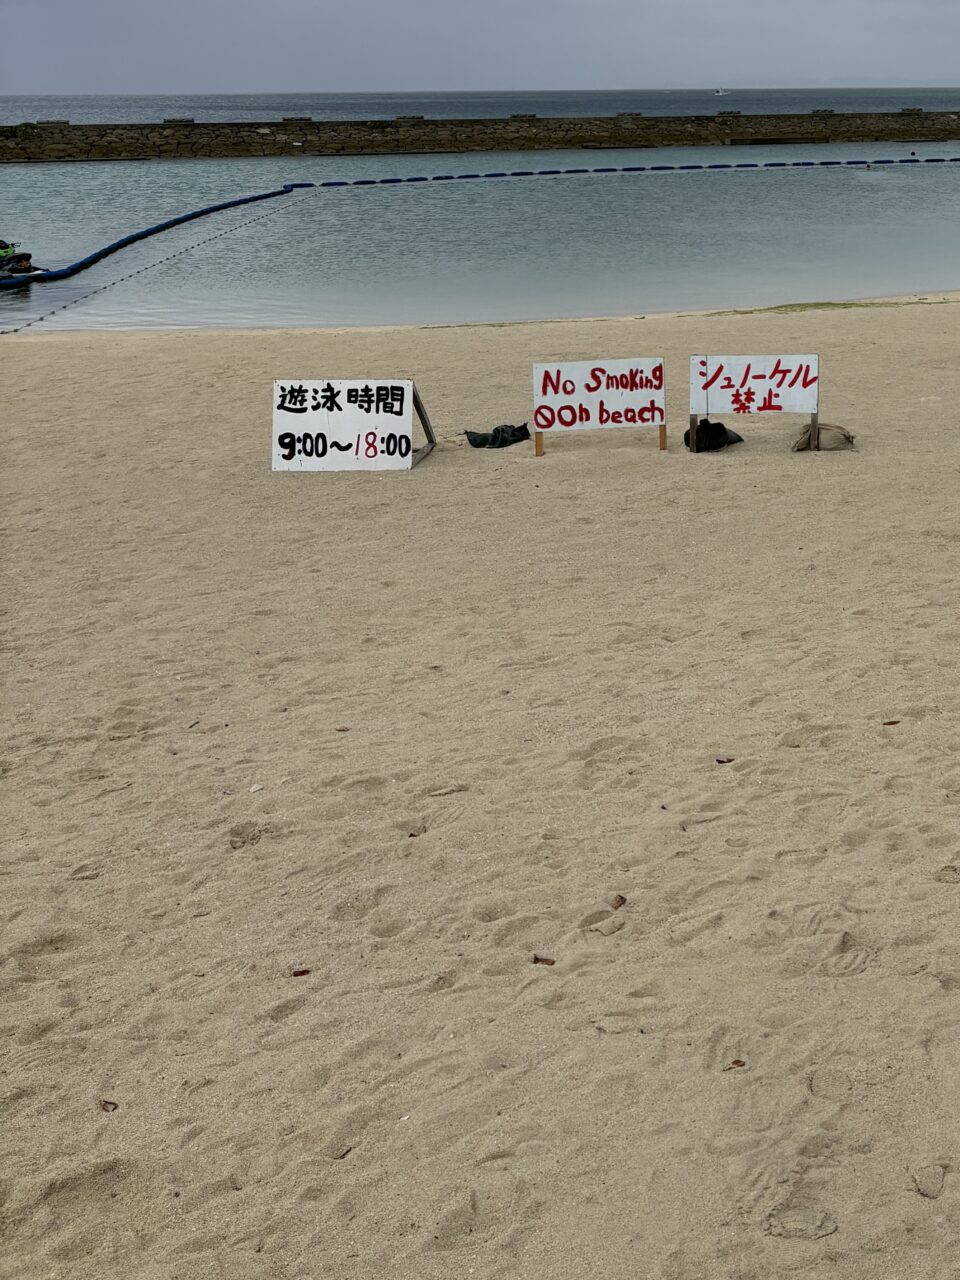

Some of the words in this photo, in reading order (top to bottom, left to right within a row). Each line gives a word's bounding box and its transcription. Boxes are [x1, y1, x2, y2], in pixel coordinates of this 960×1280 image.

[542, 369, 576, 396] No
[699, 358, 818, 390] シュノーケル
[277, 382, 404, 416] 遊泳時間
[598, 400, 664, 425] beach
[731, 387, 782, 413] 禁止
